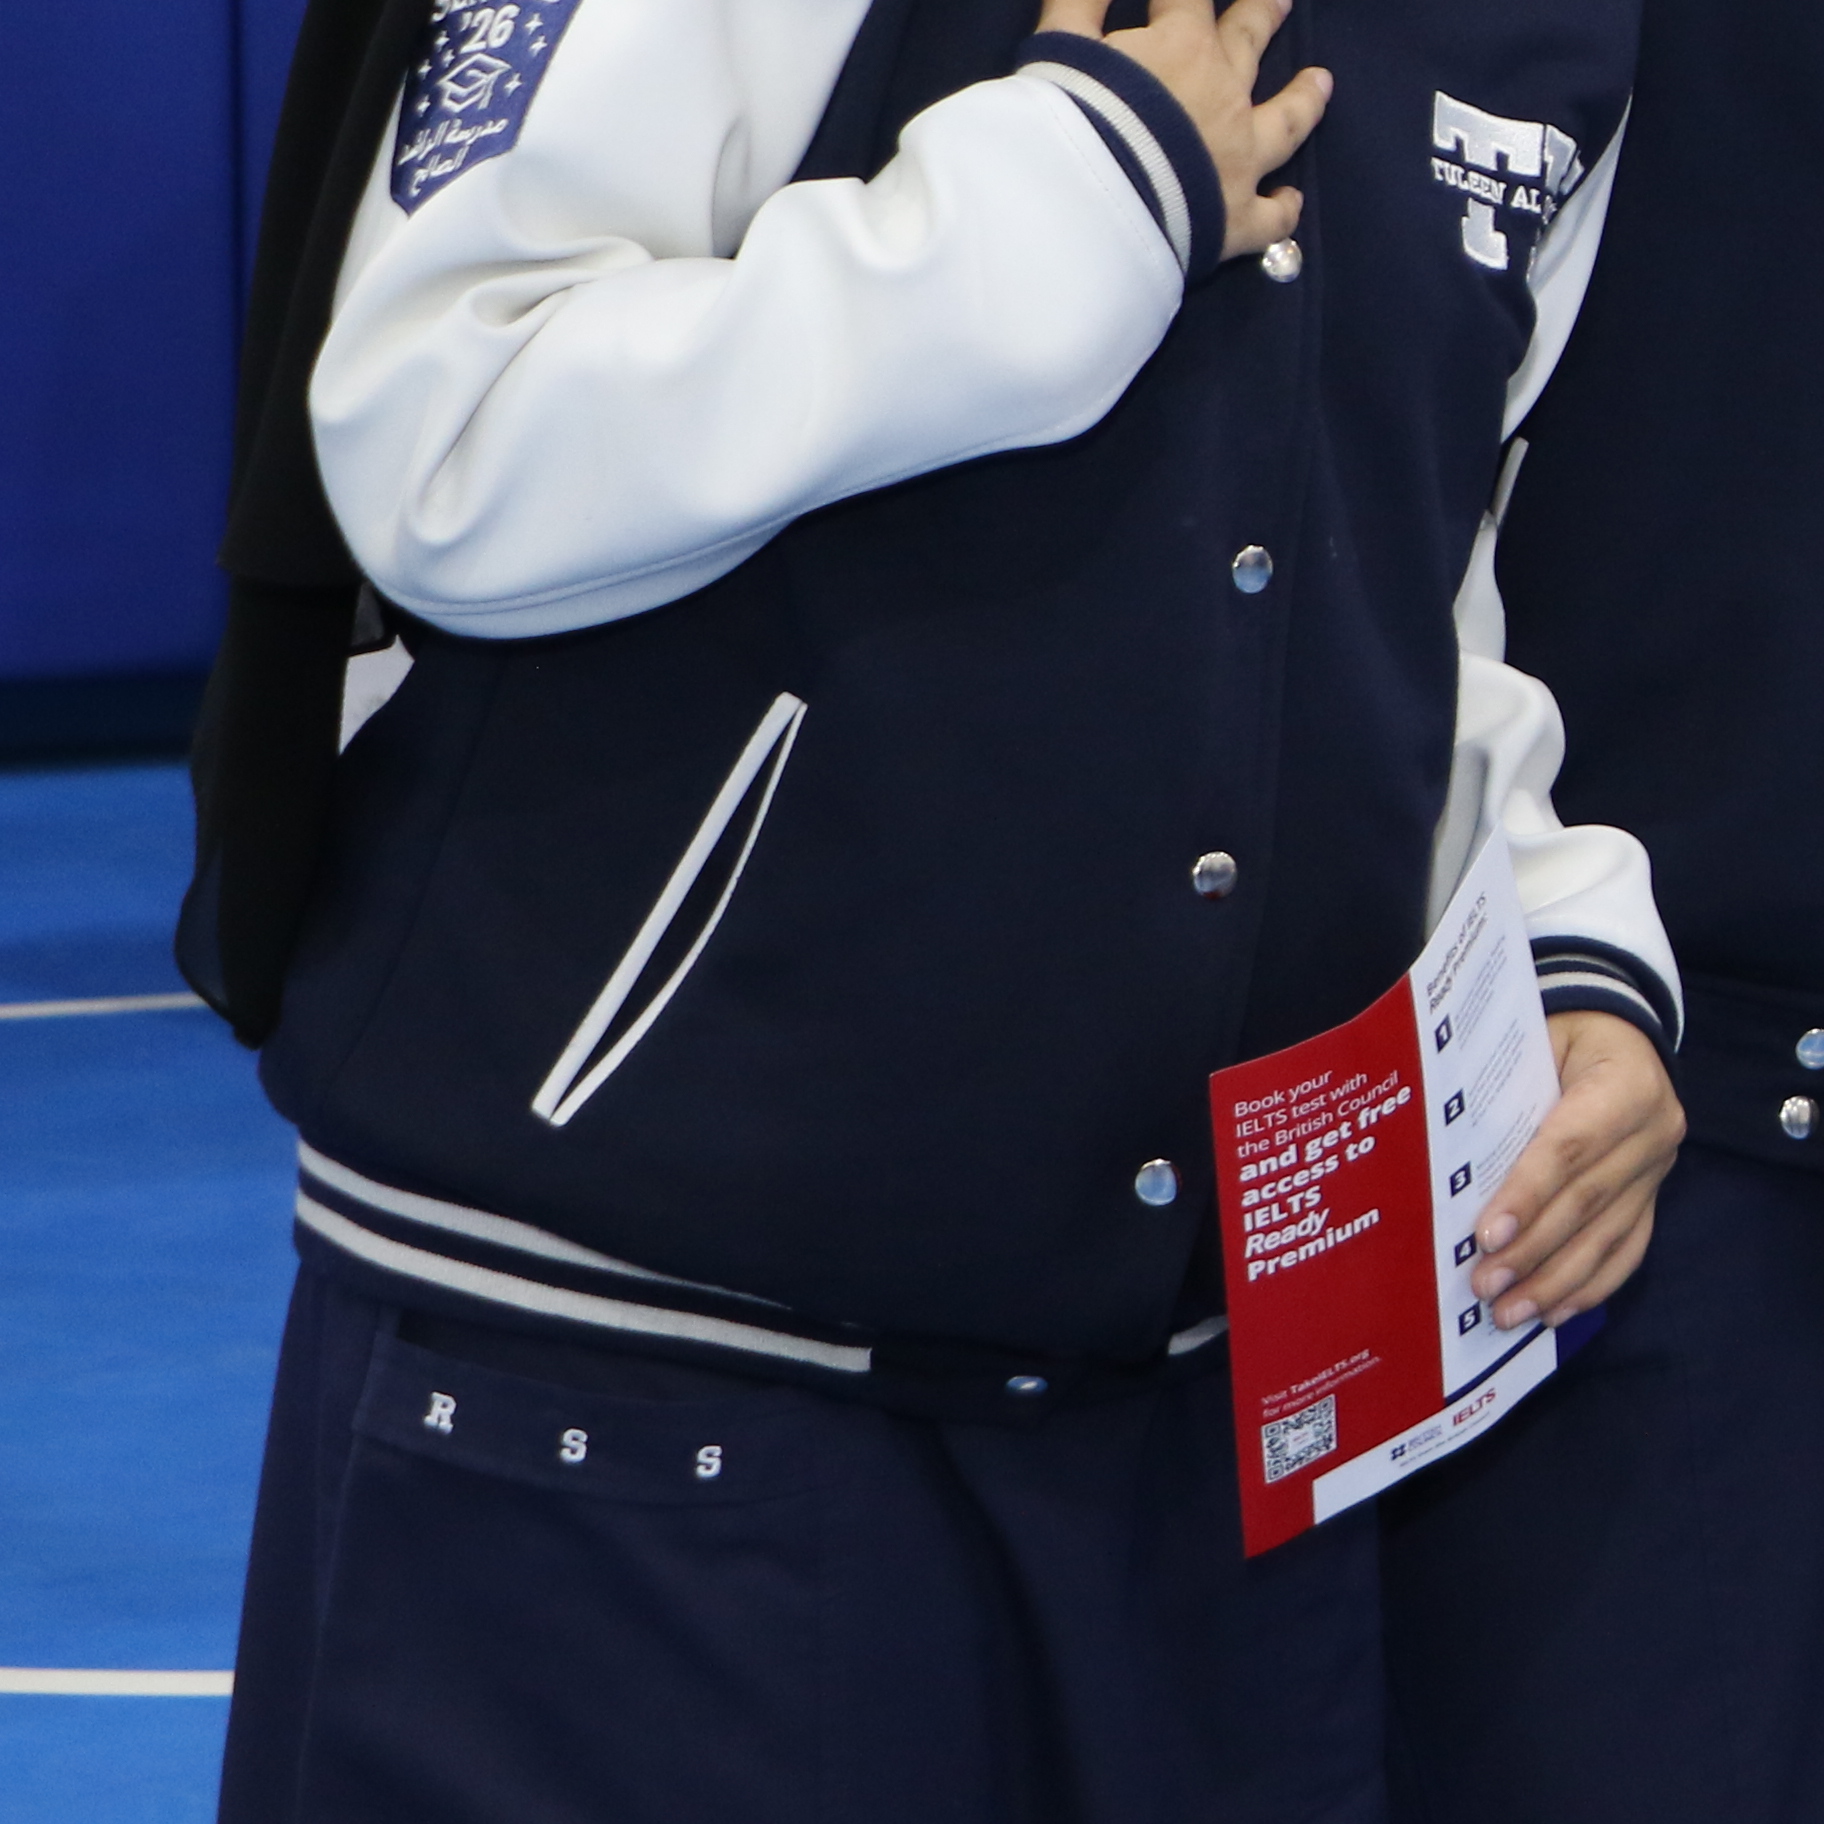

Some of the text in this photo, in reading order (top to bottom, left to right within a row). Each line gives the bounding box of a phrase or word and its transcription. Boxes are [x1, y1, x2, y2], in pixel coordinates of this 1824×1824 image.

[1234, 1070, 1332, 1117] Book your
[1236, 1073, 1367, 1138] IELTS test with
[1237, 1070, 1398, 1159] the British Council
[1240, 1085, 1412, 1182] and get free
[1241, 1136, 1376, 1207] access to
[1243, 1185, 1322, 1232] IELTS
[1244, 1208, 1329, 1258] Ready
[1248, 1208, 1380, 1282] Premium
[1452, 1388, 1496, 1426] IELTS
